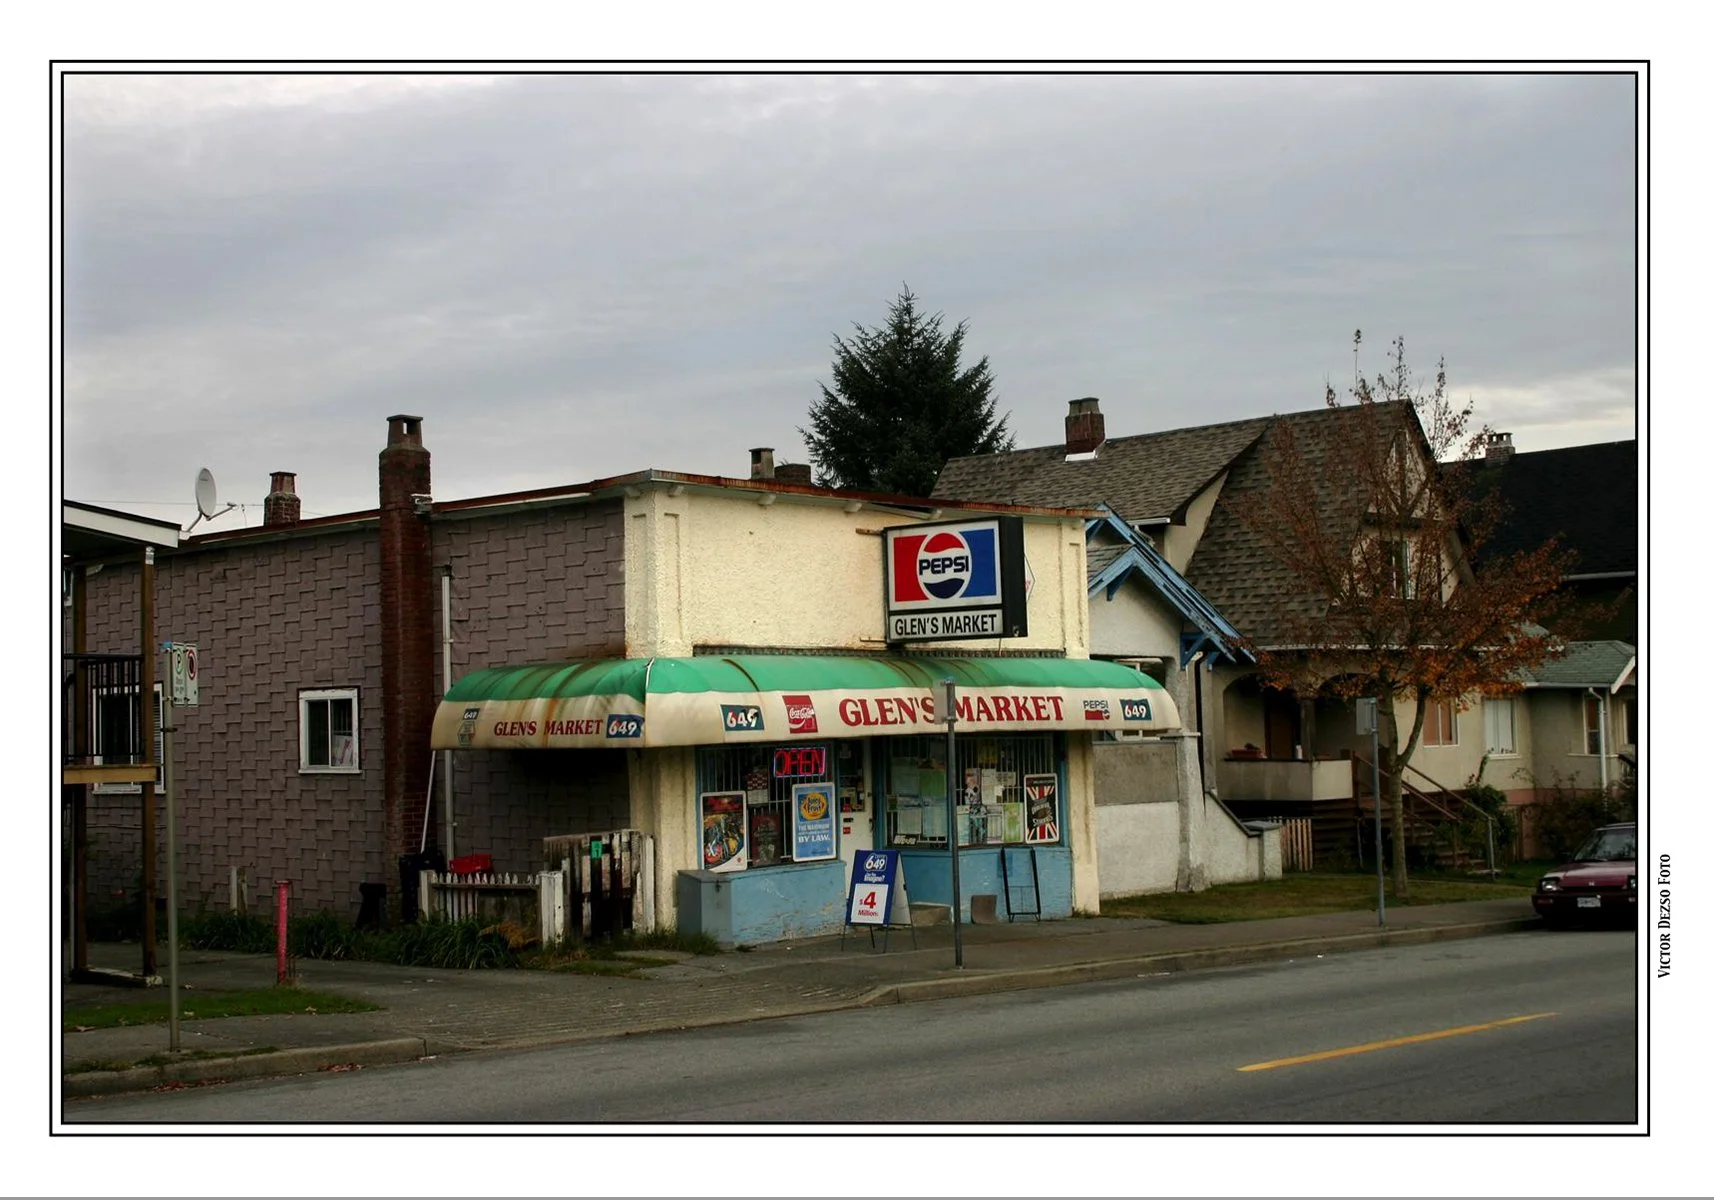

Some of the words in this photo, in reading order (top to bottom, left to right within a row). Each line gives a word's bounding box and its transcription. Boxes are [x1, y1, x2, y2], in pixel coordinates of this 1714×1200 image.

[919, 555, 969, 576] PEPSI
[895, 617, 939, 636] GLEN'S
[942, 614, 997, 634] MARKET
[838, 696, 936, 727] GLEN'S
[954, 695, 1064, 722] MARKET
[1083, 700, 1109, 709] PEPSI
[1124, 704, 1147, 719] 649
[726, 707, 759, 728] 649
[494, 720, 537, 737] GLEN'S
[544, 719, 604, 736] MARKET
[608, 720, 638, 736] 649
[775, 748, 824, 776] OPEN
[865, 855, 886, 870] 649
